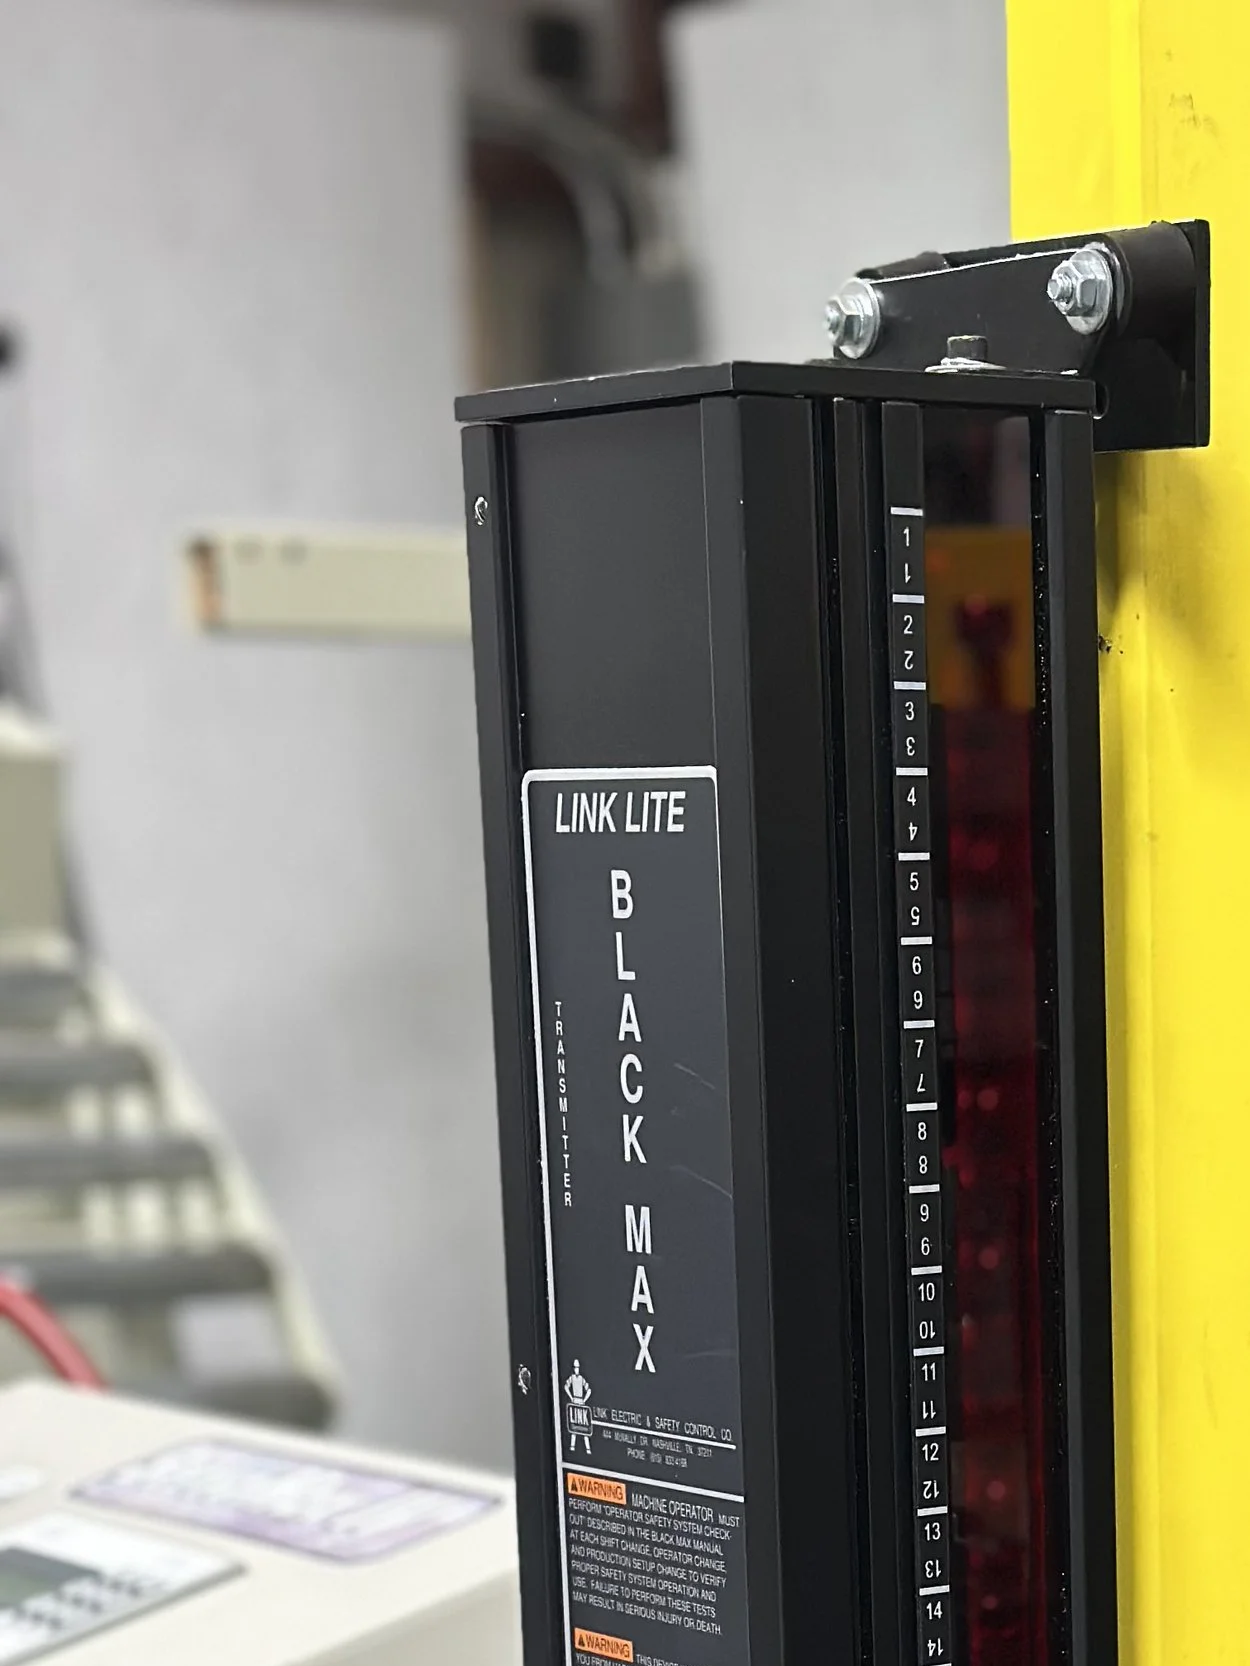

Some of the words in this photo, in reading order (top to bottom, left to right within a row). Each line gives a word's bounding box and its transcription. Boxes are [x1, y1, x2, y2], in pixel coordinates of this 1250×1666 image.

[903, 526, 910, 547] 1
[904, 562, 911, 584] 1
[903, 614, 913, 635] 2
[903, 650, 914, 670] 2
[904, 701, 915, 721] 3
[905, 736, 916, 757] 3
[906, 786, 917, 807] 4
[555, 792, 618, 833] LINK
[624, 790, 686, 833] LITE
[908, 821, 918, 841] 4
[909, 871, 920, 891] 5
[910, 906, 920, 926] 5
[911, 955, 922, 975] 6
[610, 869, 648, 1165] BLACK
[914, 1039, 924, 1058] 7
[916, 1073, 926, 1093] 7
[555, 1001, 573, 1207] TRANSMITTER
[917, 1121, 927, 1141] 8
[918, 1155, 928, 1175] 8
[919, 1203, 930, 1222] 9
[624, 1203, 656, 1374] MAX
[918, 1282, 935, 1302] 10
[919, 1320, 936, 1340] 10
[921, 1362, 936, 1382] 11
[569, 1406, 588, 1426] LINK
[922, 1400, 937, 1420] 11
[921, 1442, 939, 1462] 12
[578, 1478, 623, 1500] WARNING
[922, 1479, 940, 1500] 12
[924, 1522, 941, 1541] 13
[924, 1559, 942, 1579] 13
[926, 1600, 943, 1620] 14
[586, 1634, 629, 1658] WARNING
[927, 1637, 944, 1657] 14
